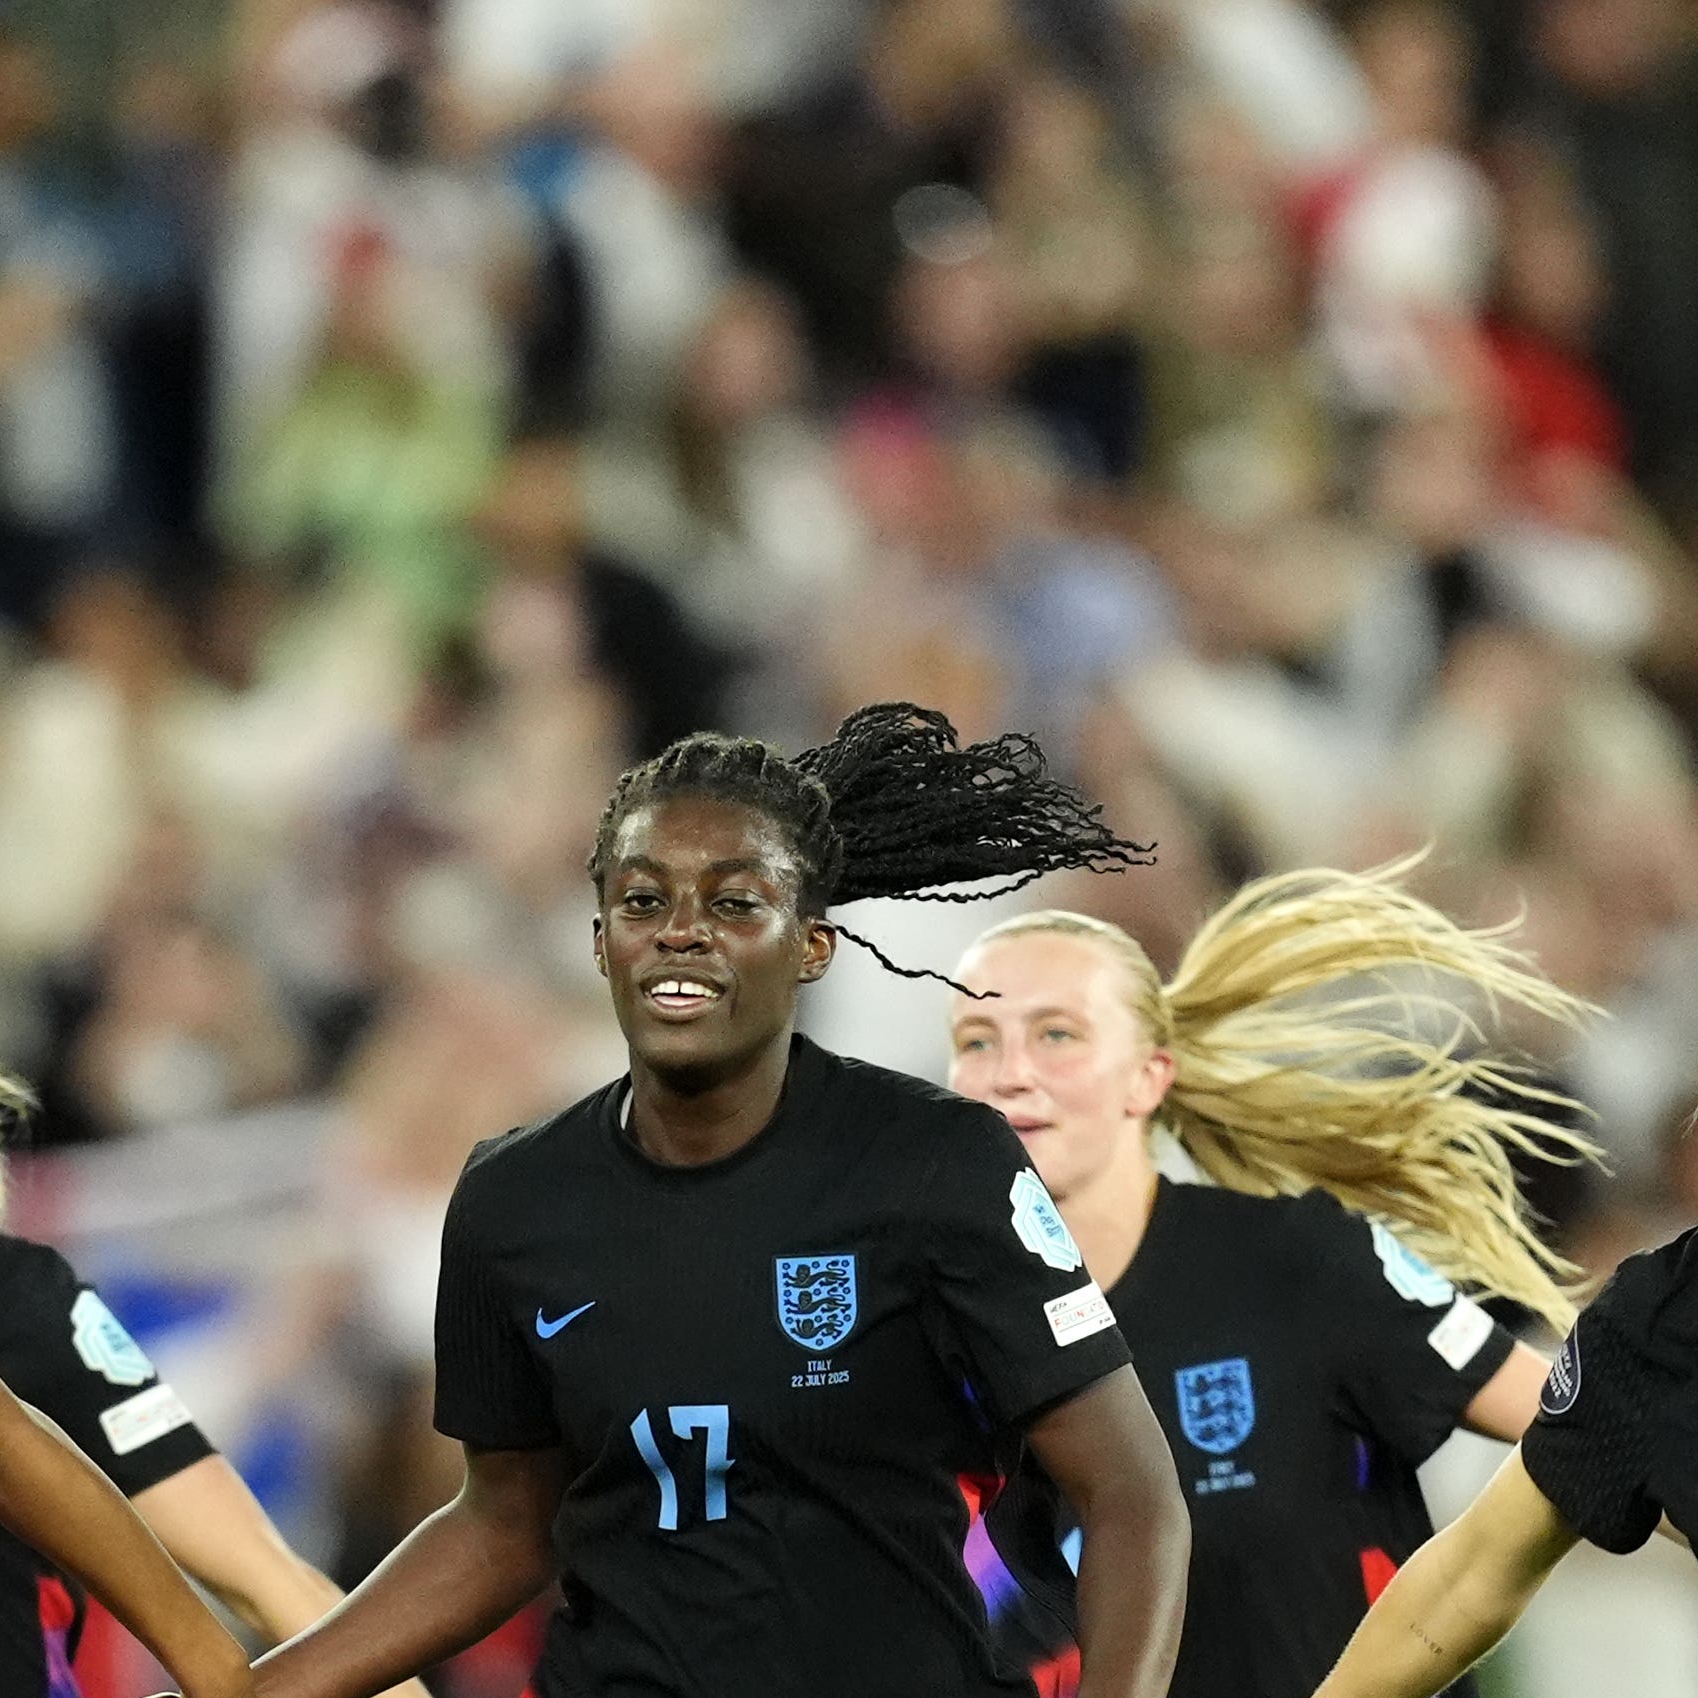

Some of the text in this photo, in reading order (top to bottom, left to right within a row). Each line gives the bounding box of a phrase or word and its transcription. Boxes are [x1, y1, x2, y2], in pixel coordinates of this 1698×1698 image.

[806, 1359, 832, 1373] ITALY
[791, 1370, 850, 1388] 22 JULY 2025
[630, 1404, 736, 1531] 17
